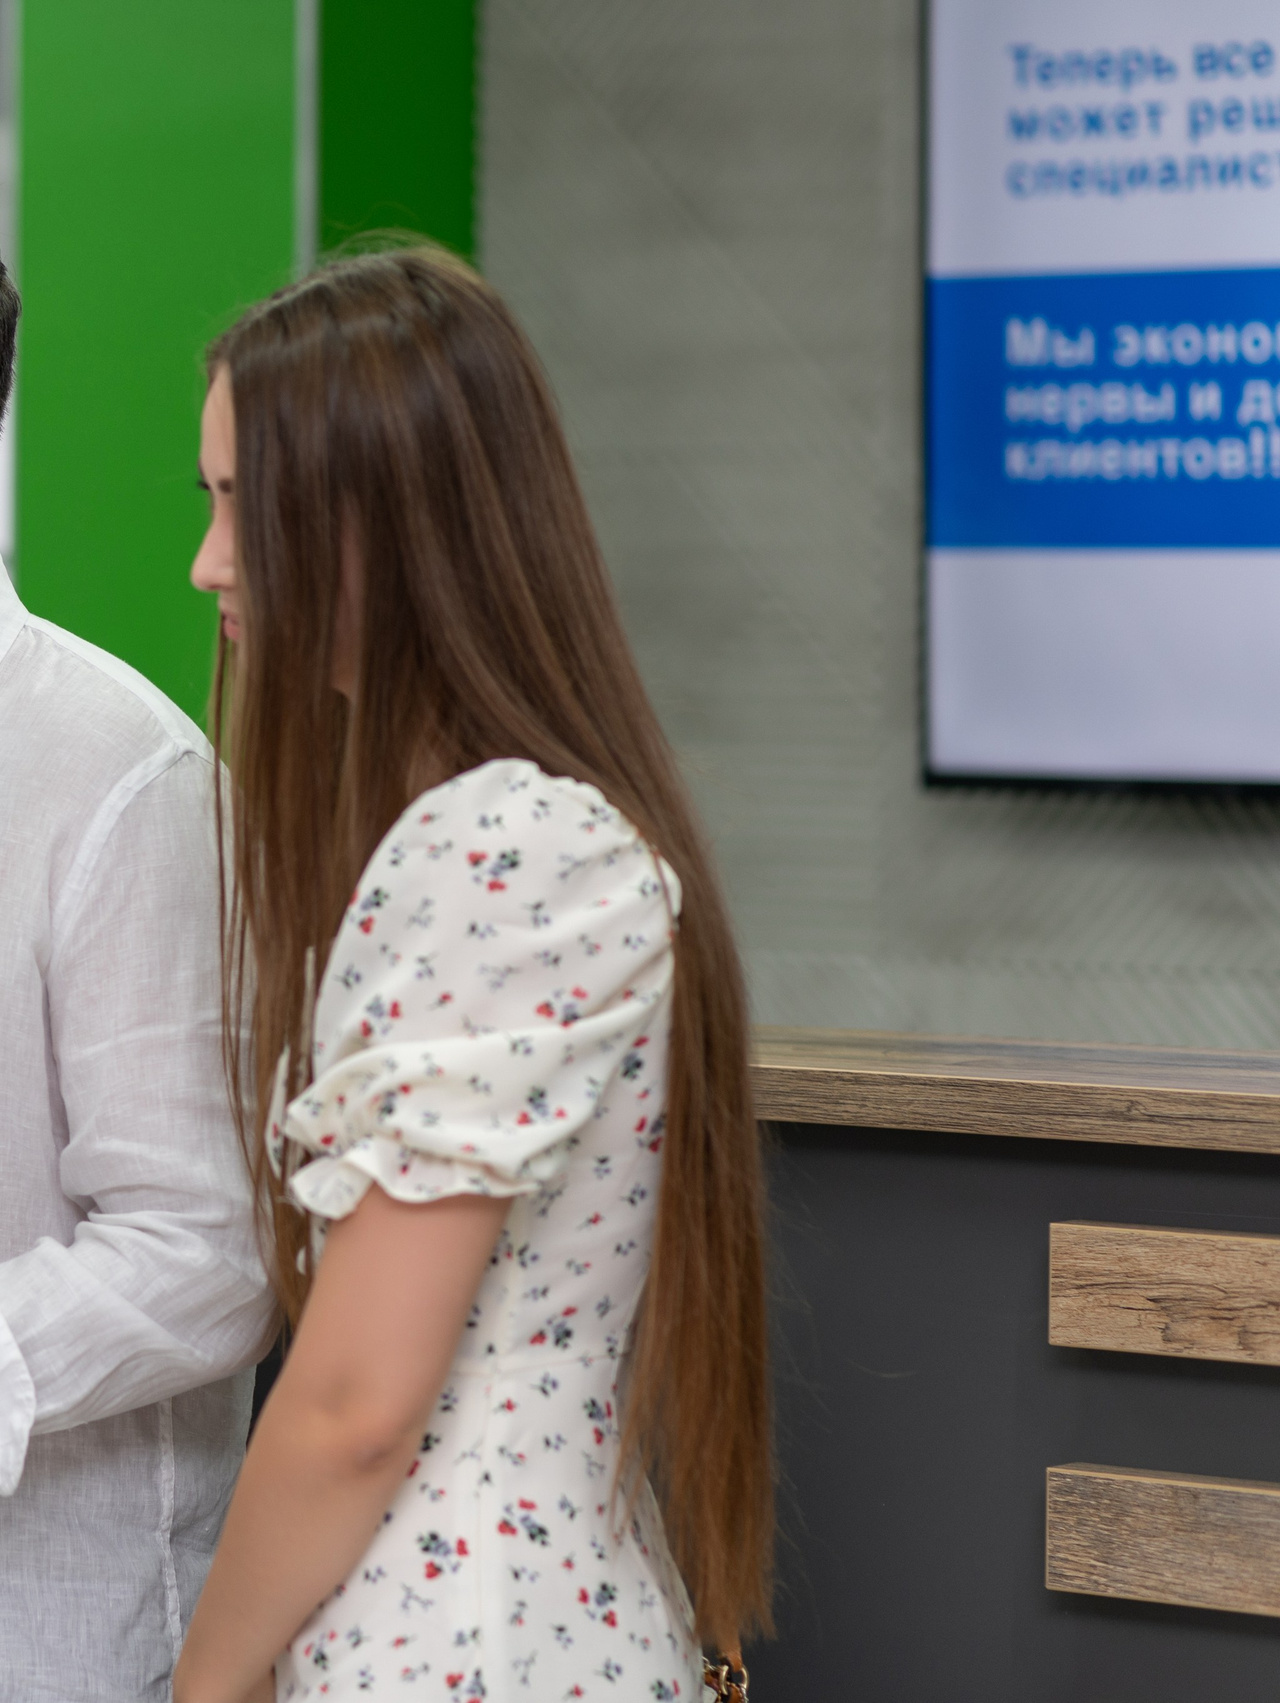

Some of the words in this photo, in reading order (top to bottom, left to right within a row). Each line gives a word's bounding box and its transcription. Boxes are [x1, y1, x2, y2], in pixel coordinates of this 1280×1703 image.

[1004, 41, 1178, 88] Теперь
[1192, 40, 1275, 80] все
[1005, 101, 1165, 143] может
[1005, 152, 1280, 199] специалис
[1005, 315, 1096, 367] Мы
[1112, 321, 1280, 366] эконо
[1005, 380, 1176, 433] нервы
[1188, 380, 1222, 422] и
[1236, 379, 1280, 428] д
